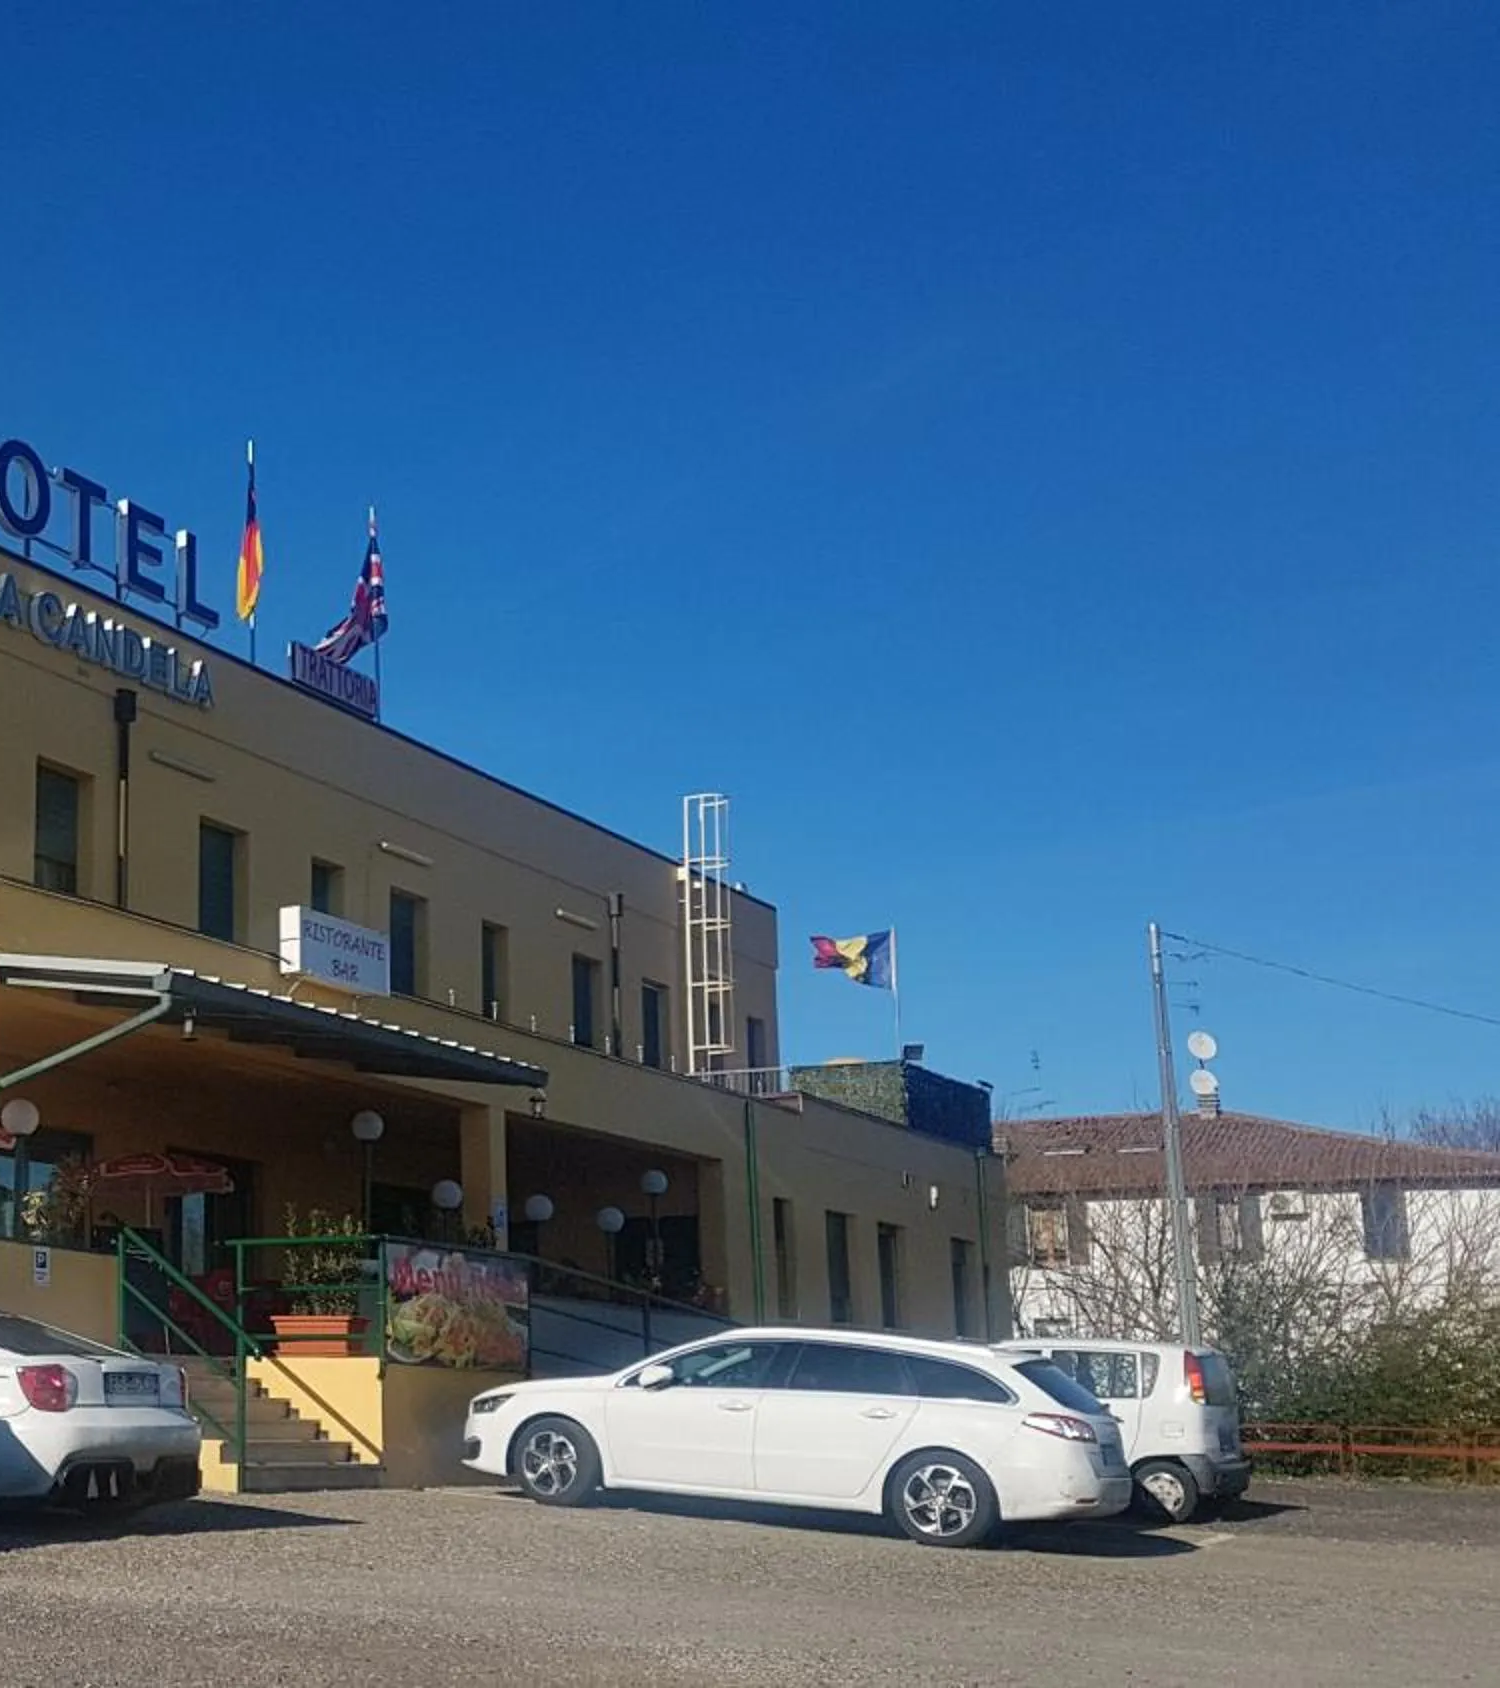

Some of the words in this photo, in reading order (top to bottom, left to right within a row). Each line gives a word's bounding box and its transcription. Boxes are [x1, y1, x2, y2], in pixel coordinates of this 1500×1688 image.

[30, 590, 215, 707] CANDELA
[298, 646, 377, 706] TRATTORIA
[301, 919, 386, 962] RISTORANTE
[330, 958, 360, 983] BAR
